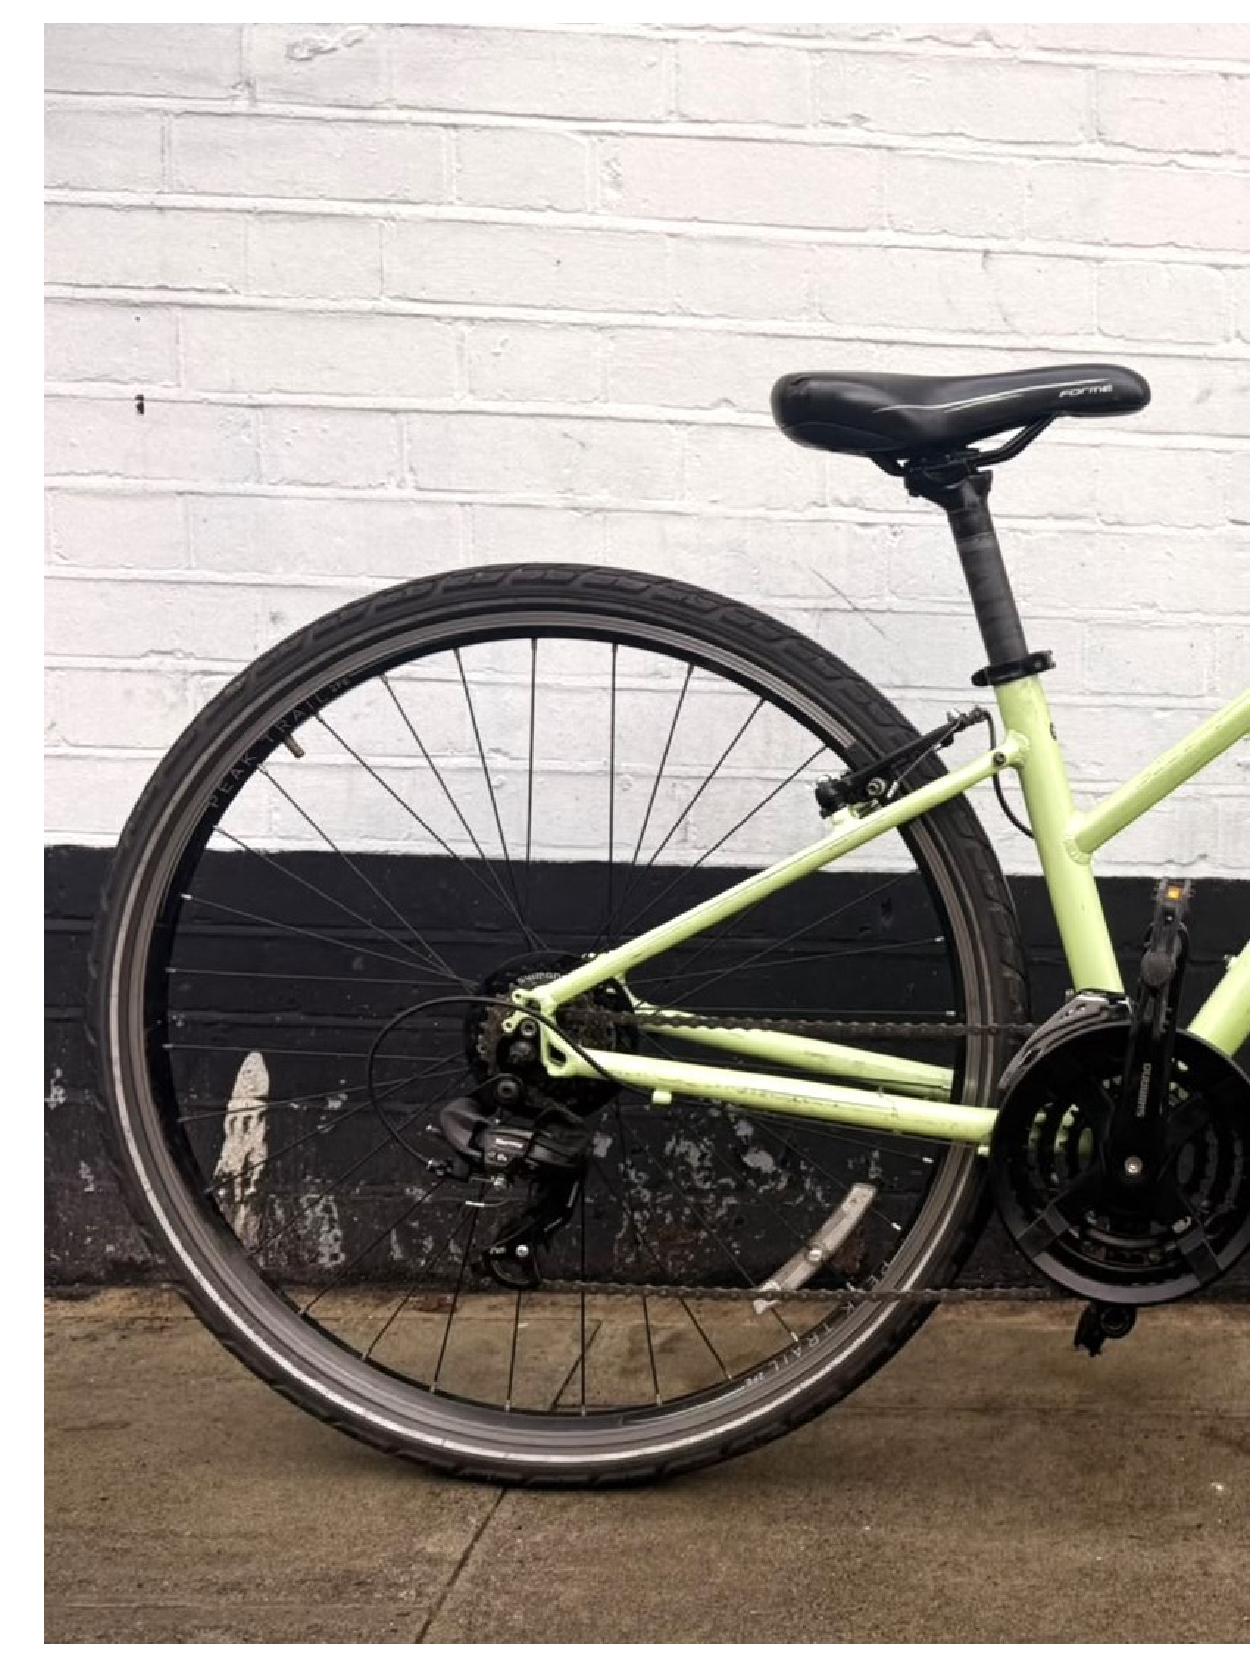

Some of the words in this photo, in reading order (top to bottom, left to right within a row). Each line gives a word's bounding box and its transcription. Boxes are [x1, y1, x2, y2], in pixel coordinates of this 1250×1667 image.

[209, 752, 259, 808] PEAK
[263, 692, 326, 743] TRAIL
[769, 1322, 833, 1371] TRAIL
